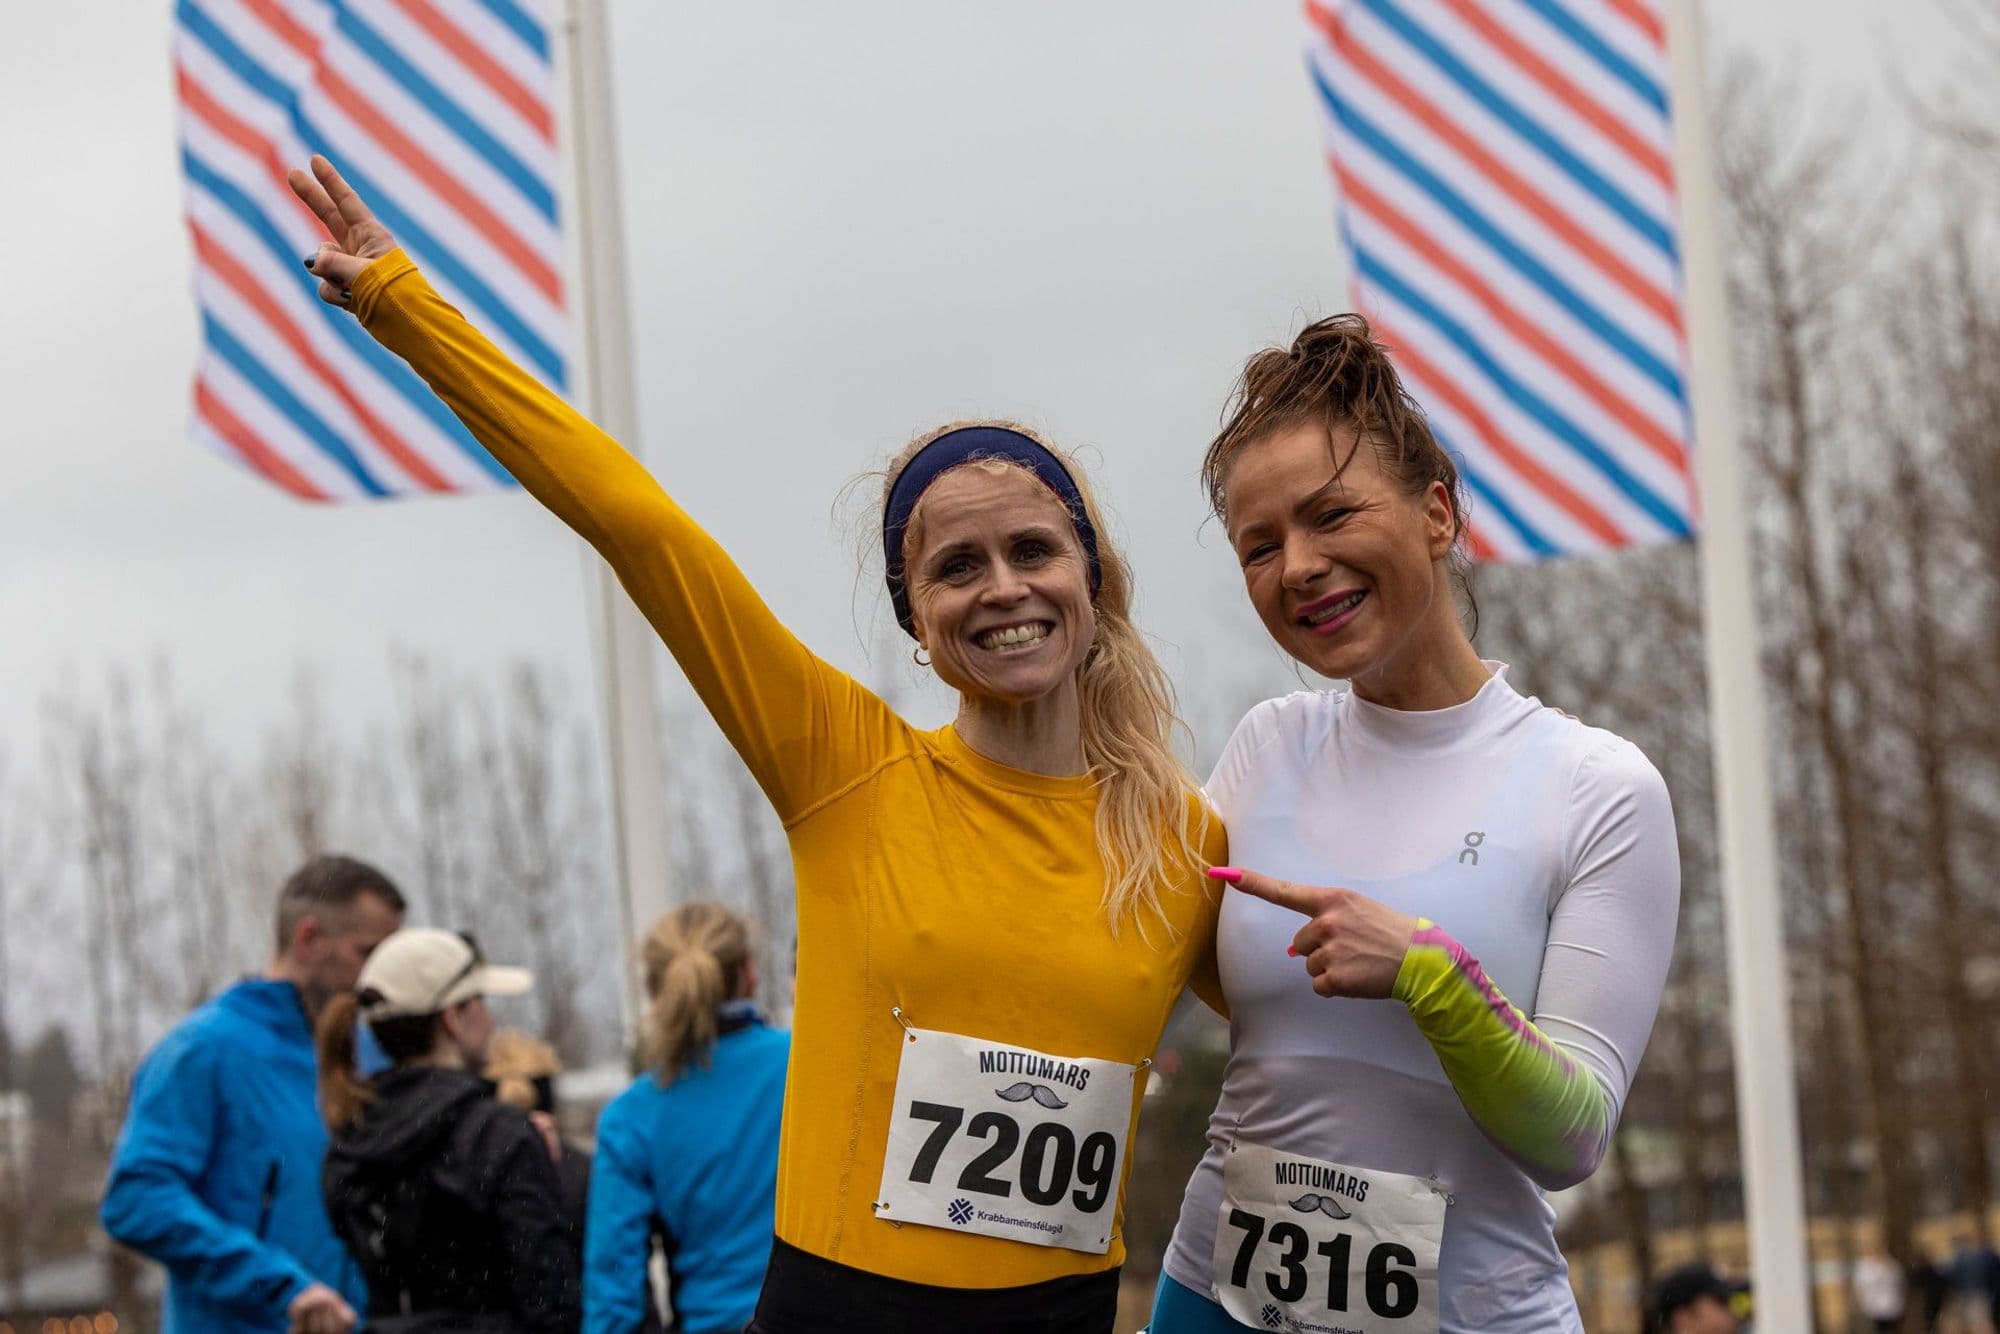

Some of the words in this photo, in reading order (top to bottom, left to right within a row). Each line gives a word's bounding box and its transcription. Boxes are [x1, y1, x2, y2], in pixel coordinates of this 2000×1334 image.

[979, 1051, 1091, 1091] MOTTUMARS
[908, 1100, 1117, 1213] 7209
[1275, 1162, 1369, 1202] MOTTUMARS
[977, 1210, 1064, 1234] Krabbameinsfélagið
[1229, 1208, 1419, 1319] 7316
